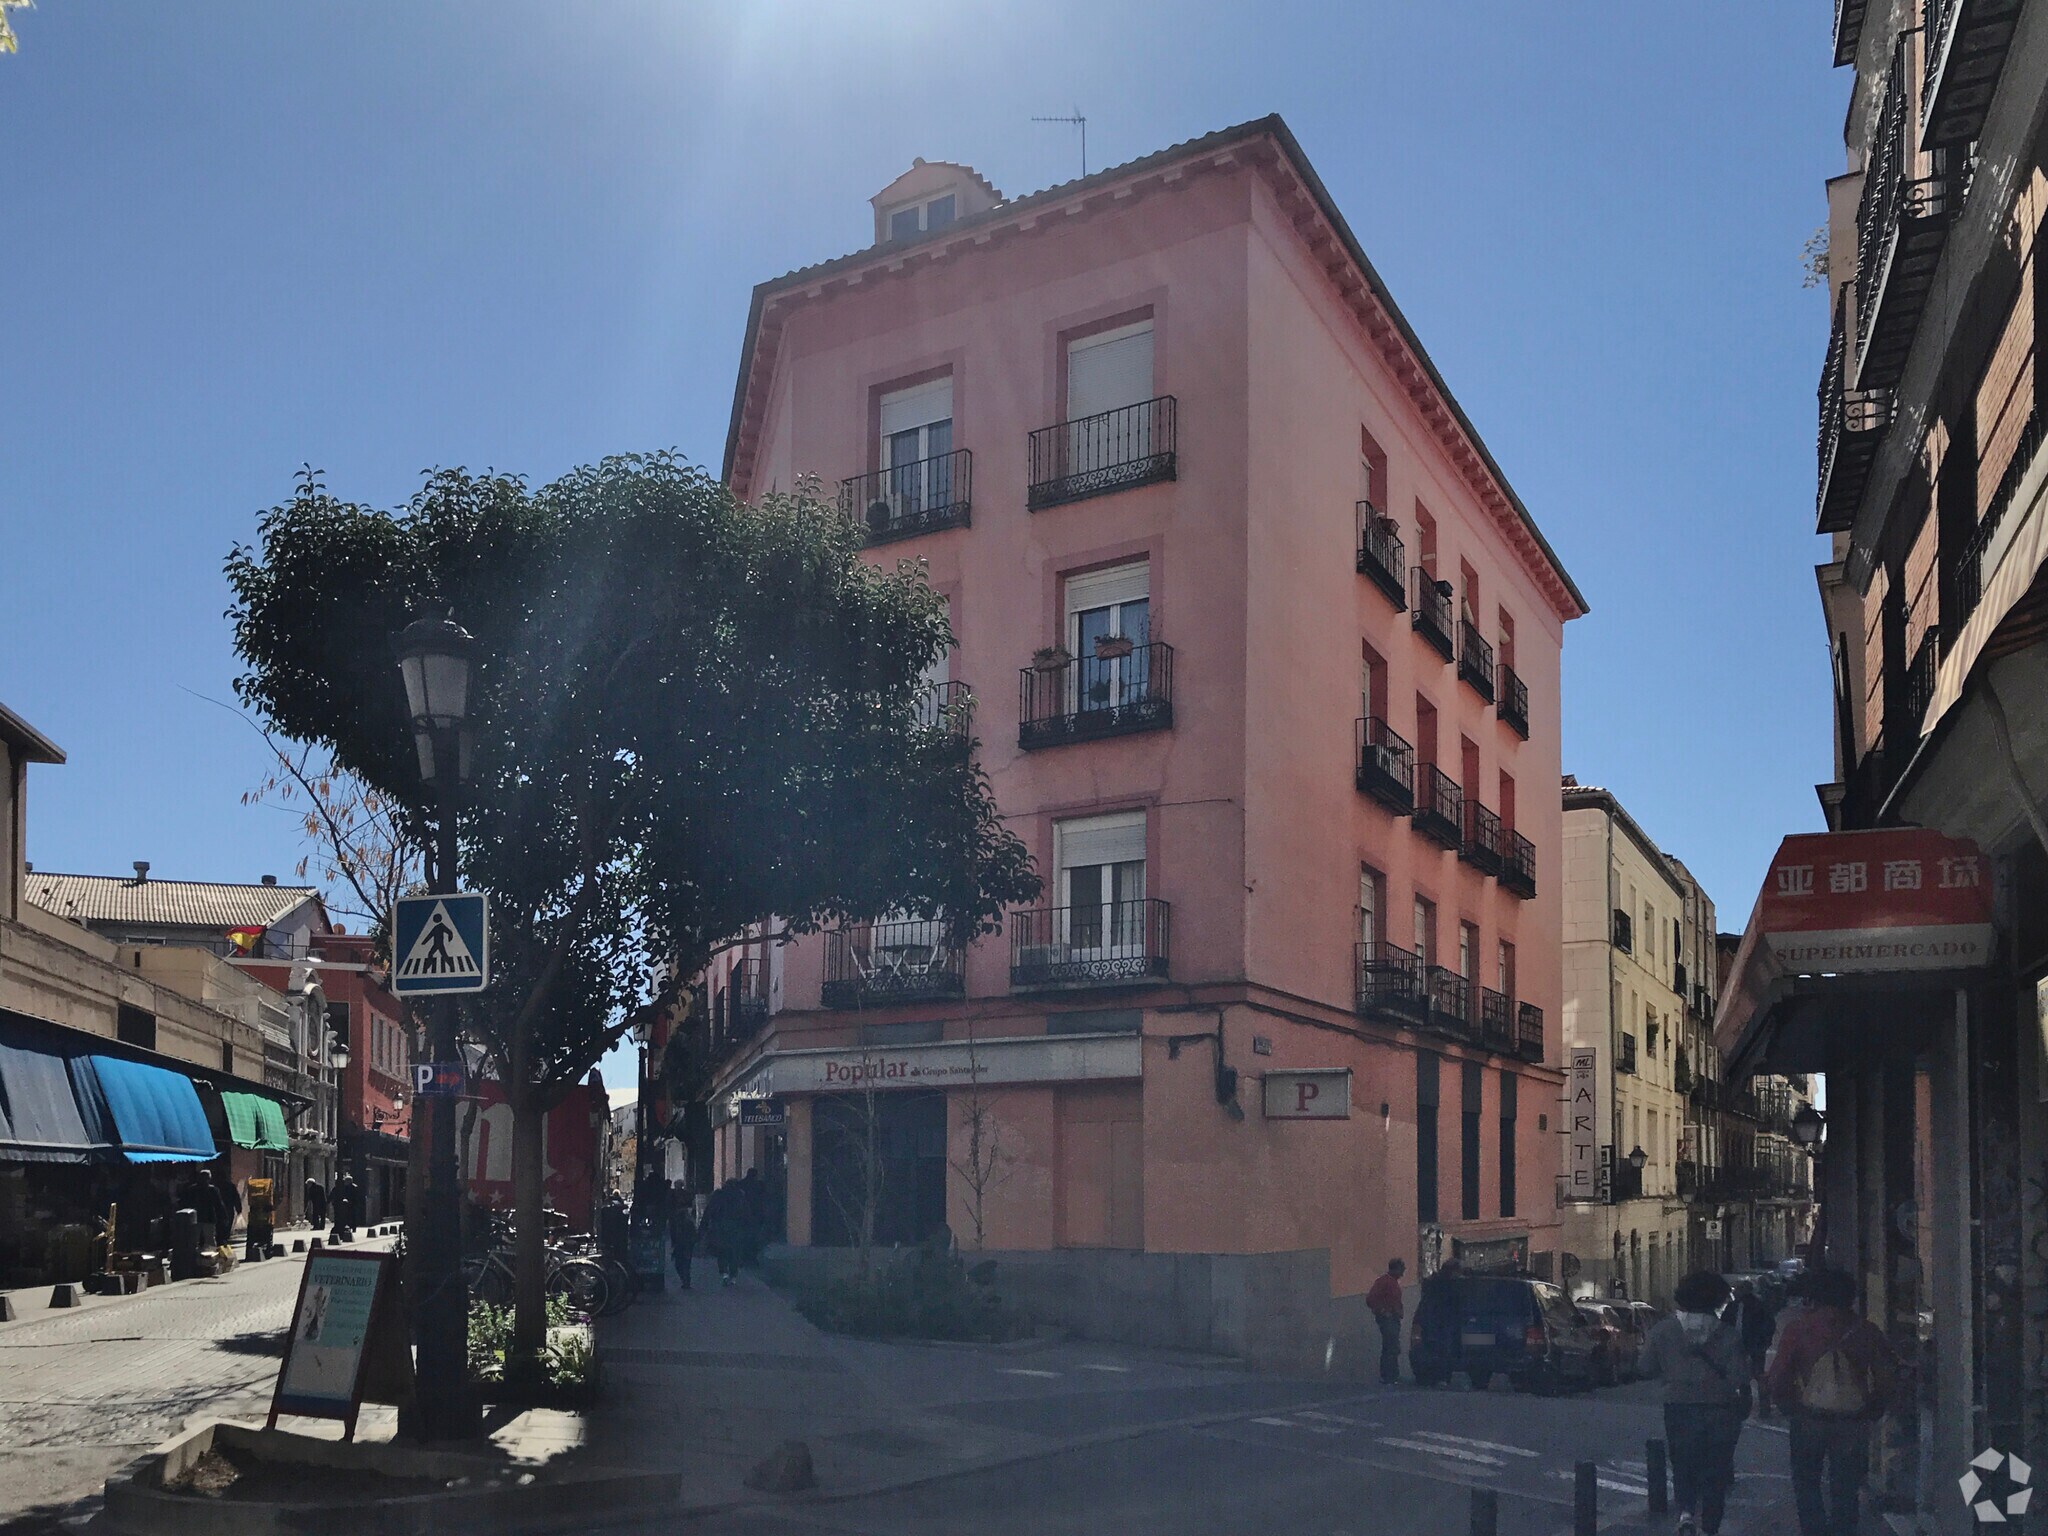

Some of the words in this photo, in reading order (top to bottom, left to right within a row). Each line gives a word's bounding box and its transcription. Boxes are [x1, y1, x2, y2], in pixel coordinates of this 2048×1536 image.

[1776, 856, 1980, 896] 亚都商场
[1776, 941, 1977, 962] SUPERMERCADO
[417, 1065, 433, 1094] P
[825, 1058, 909, 1084] Popular
[922, 1067, 948, 1077] Grupo
[1295, 1082, 1319, 1111] P
[744, 1114, 782, 1123] TELEBANCO
[1575, 1088, 1592, 1185] ARTE
[314, 1274, 373, 1287] VETERINARIO
